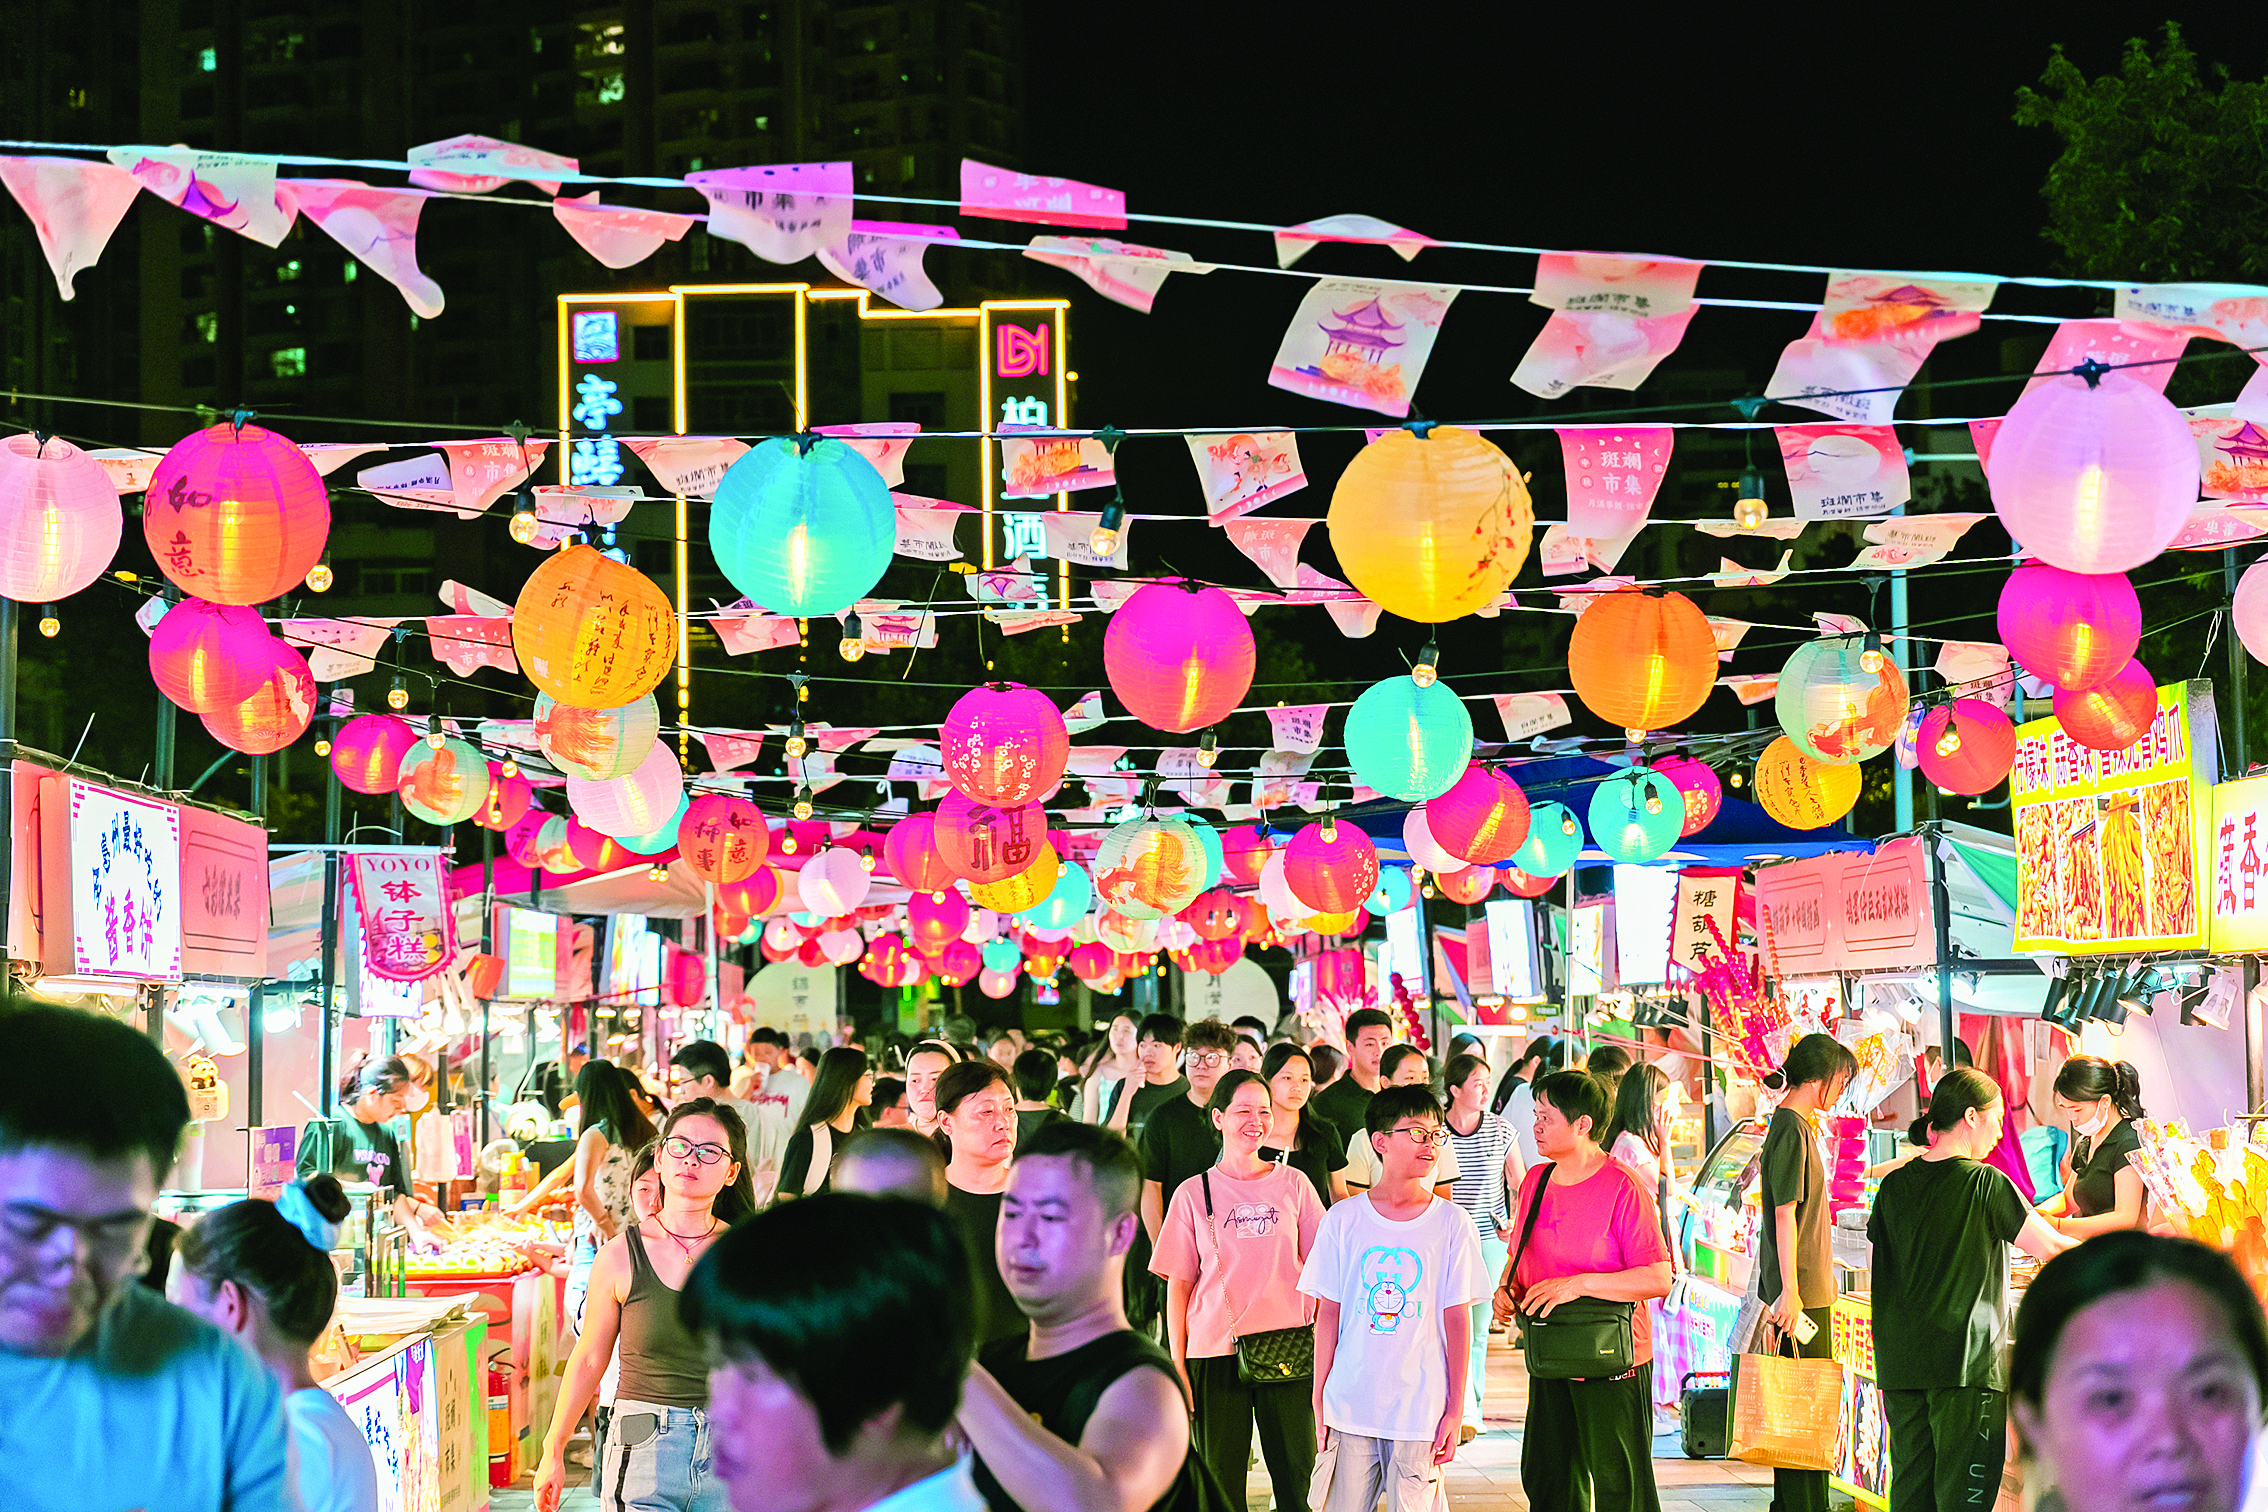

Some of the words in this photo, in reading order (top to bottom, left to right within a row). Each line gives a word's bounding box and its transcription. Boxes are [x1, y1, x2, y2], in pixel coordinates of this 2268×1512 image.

[1601, 451, 1642, 471] 斑斓
[1602, 473, 1642, 496] 市集
[165, 475, 212, 577] 如意
[461, 652, 489, 666] 市集
[968, 804, 1031, 871] 福
[367, 858, 430, 873] YOYO
[105, 888, 154, 969] 酱香饼
[381, 880, 429, 963] 钵子糕
[1690, 890, 1717, 961] 糖葫芦
[1355, 1297, 1422, 1319] GCI
